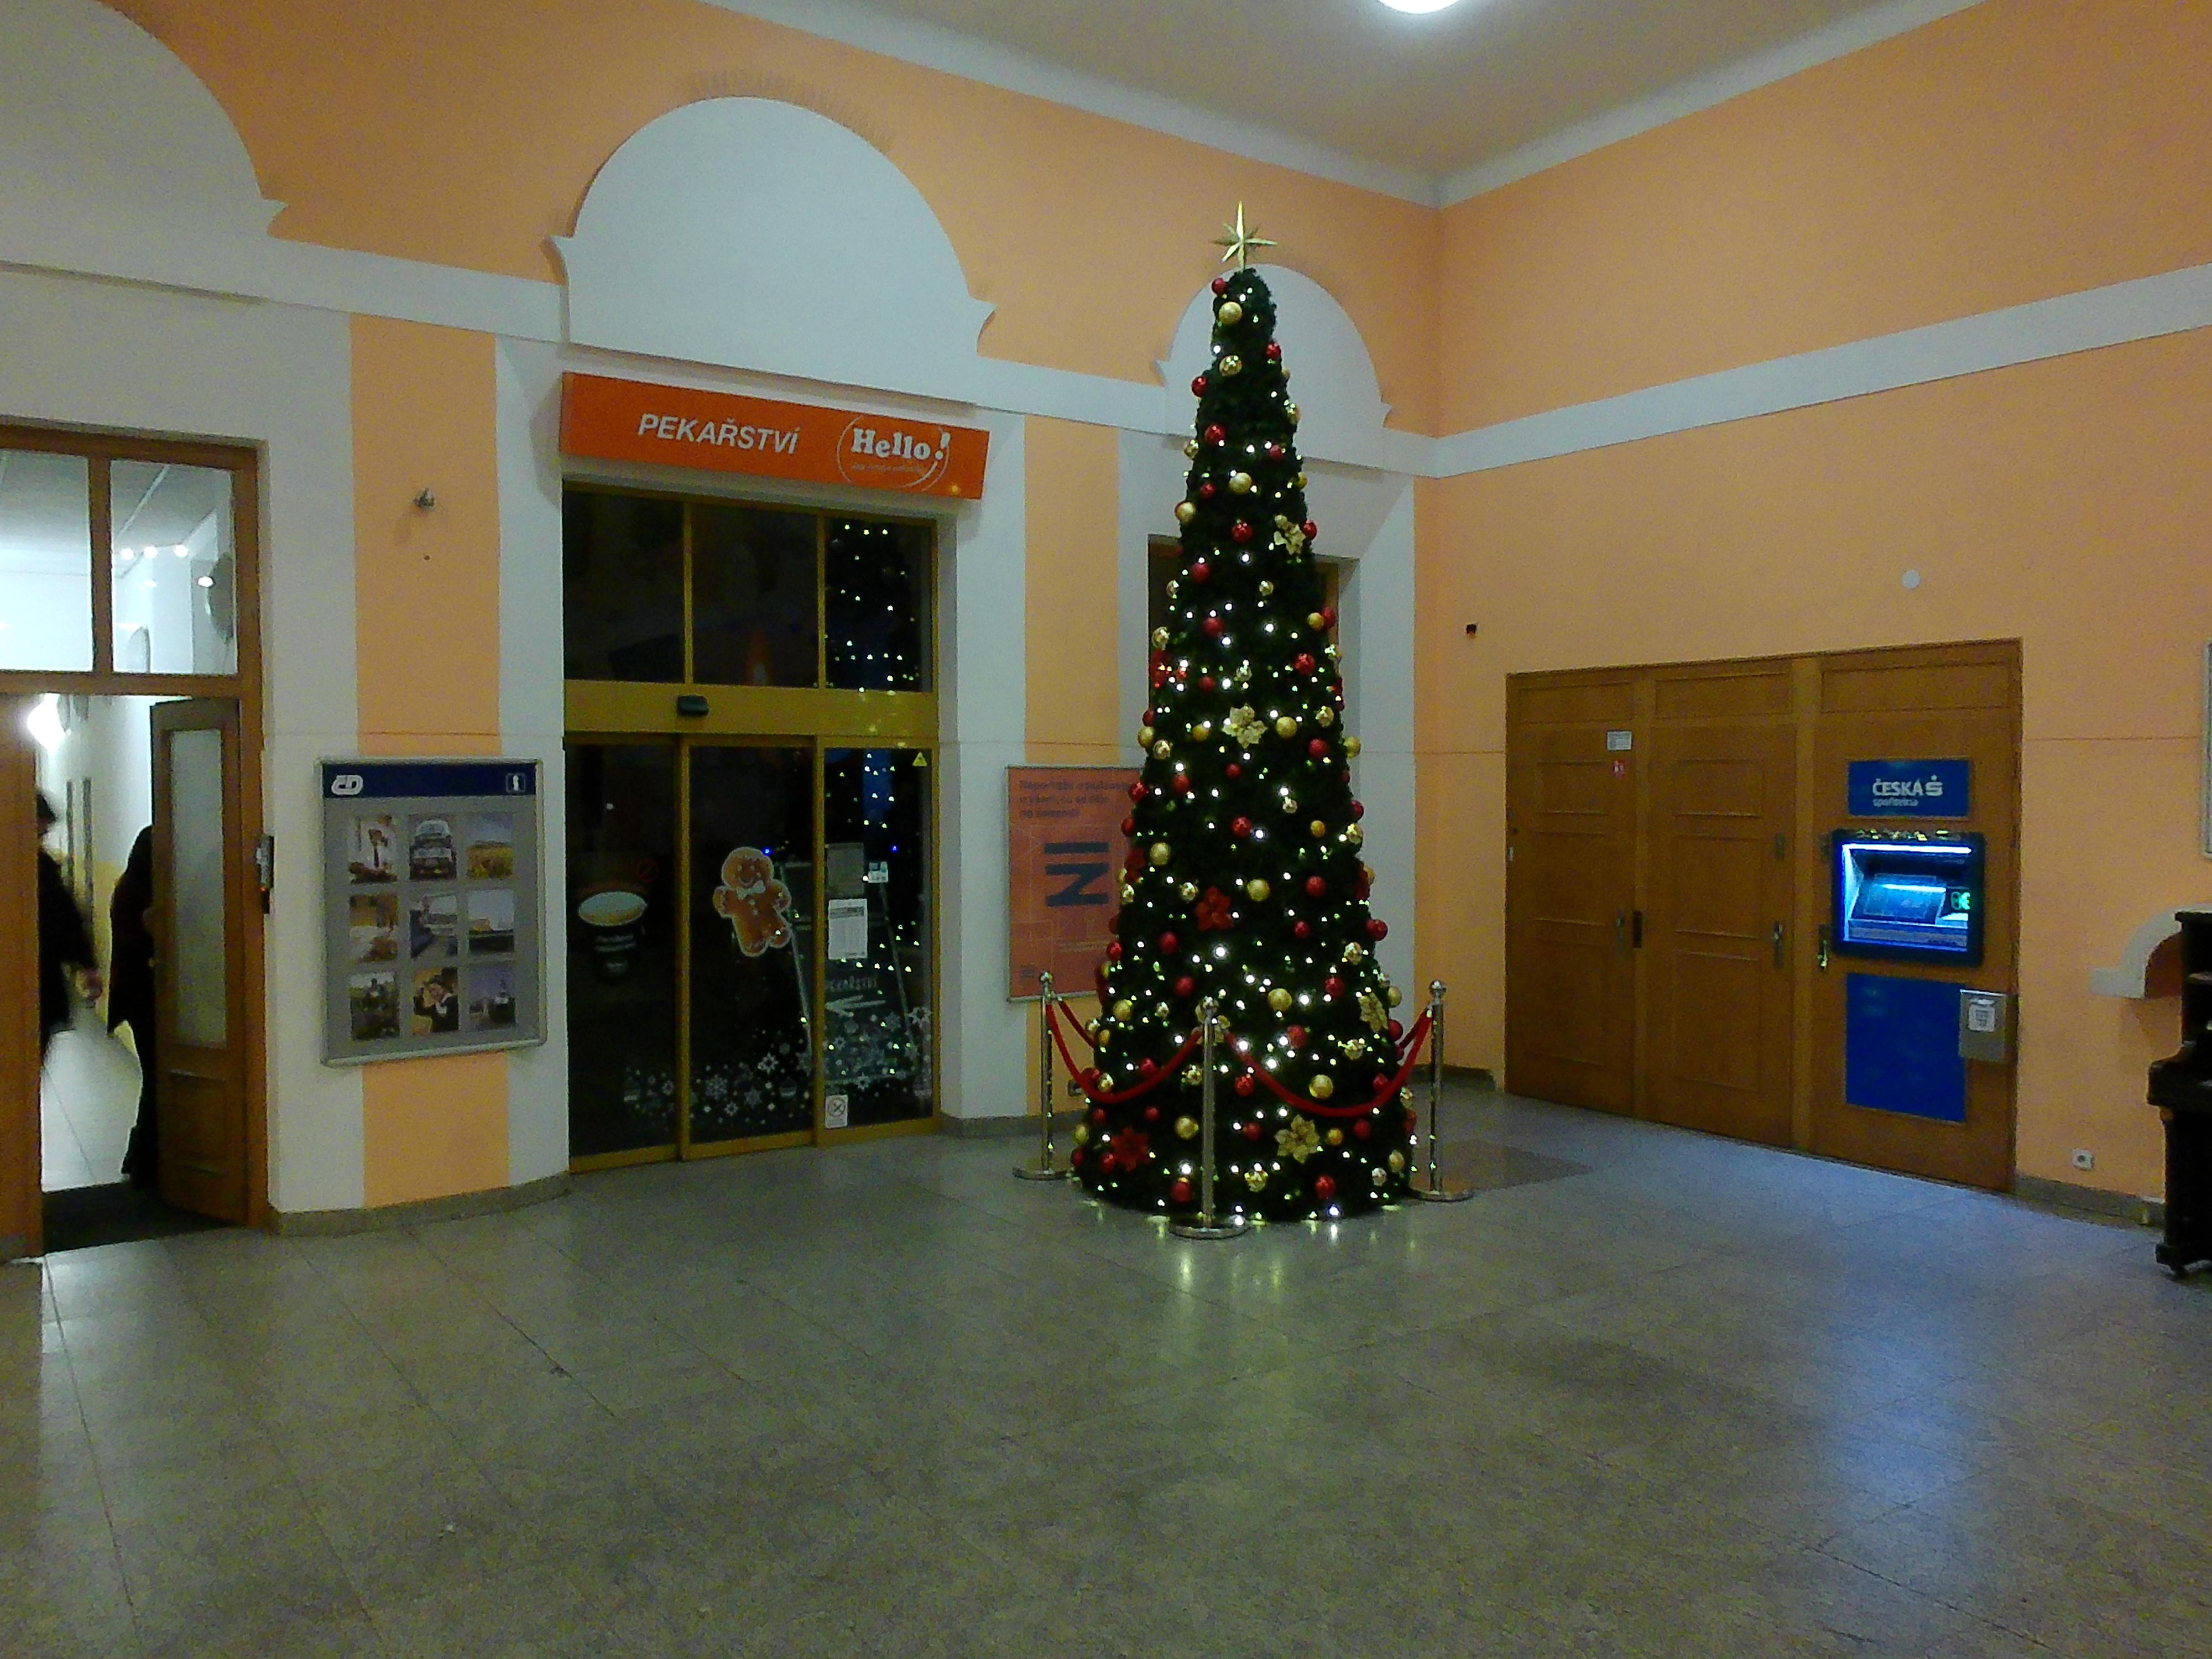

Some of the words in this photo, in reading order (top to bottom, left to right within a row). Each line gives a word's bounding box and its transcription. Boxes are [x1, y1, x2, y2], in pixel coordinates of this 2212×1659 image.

[638, 413, 800, 455] PEKAŘSTVÍ
[851, 427, 951, 460] Hello!
[1872, 777, 1923, 796] ČESKÁ
